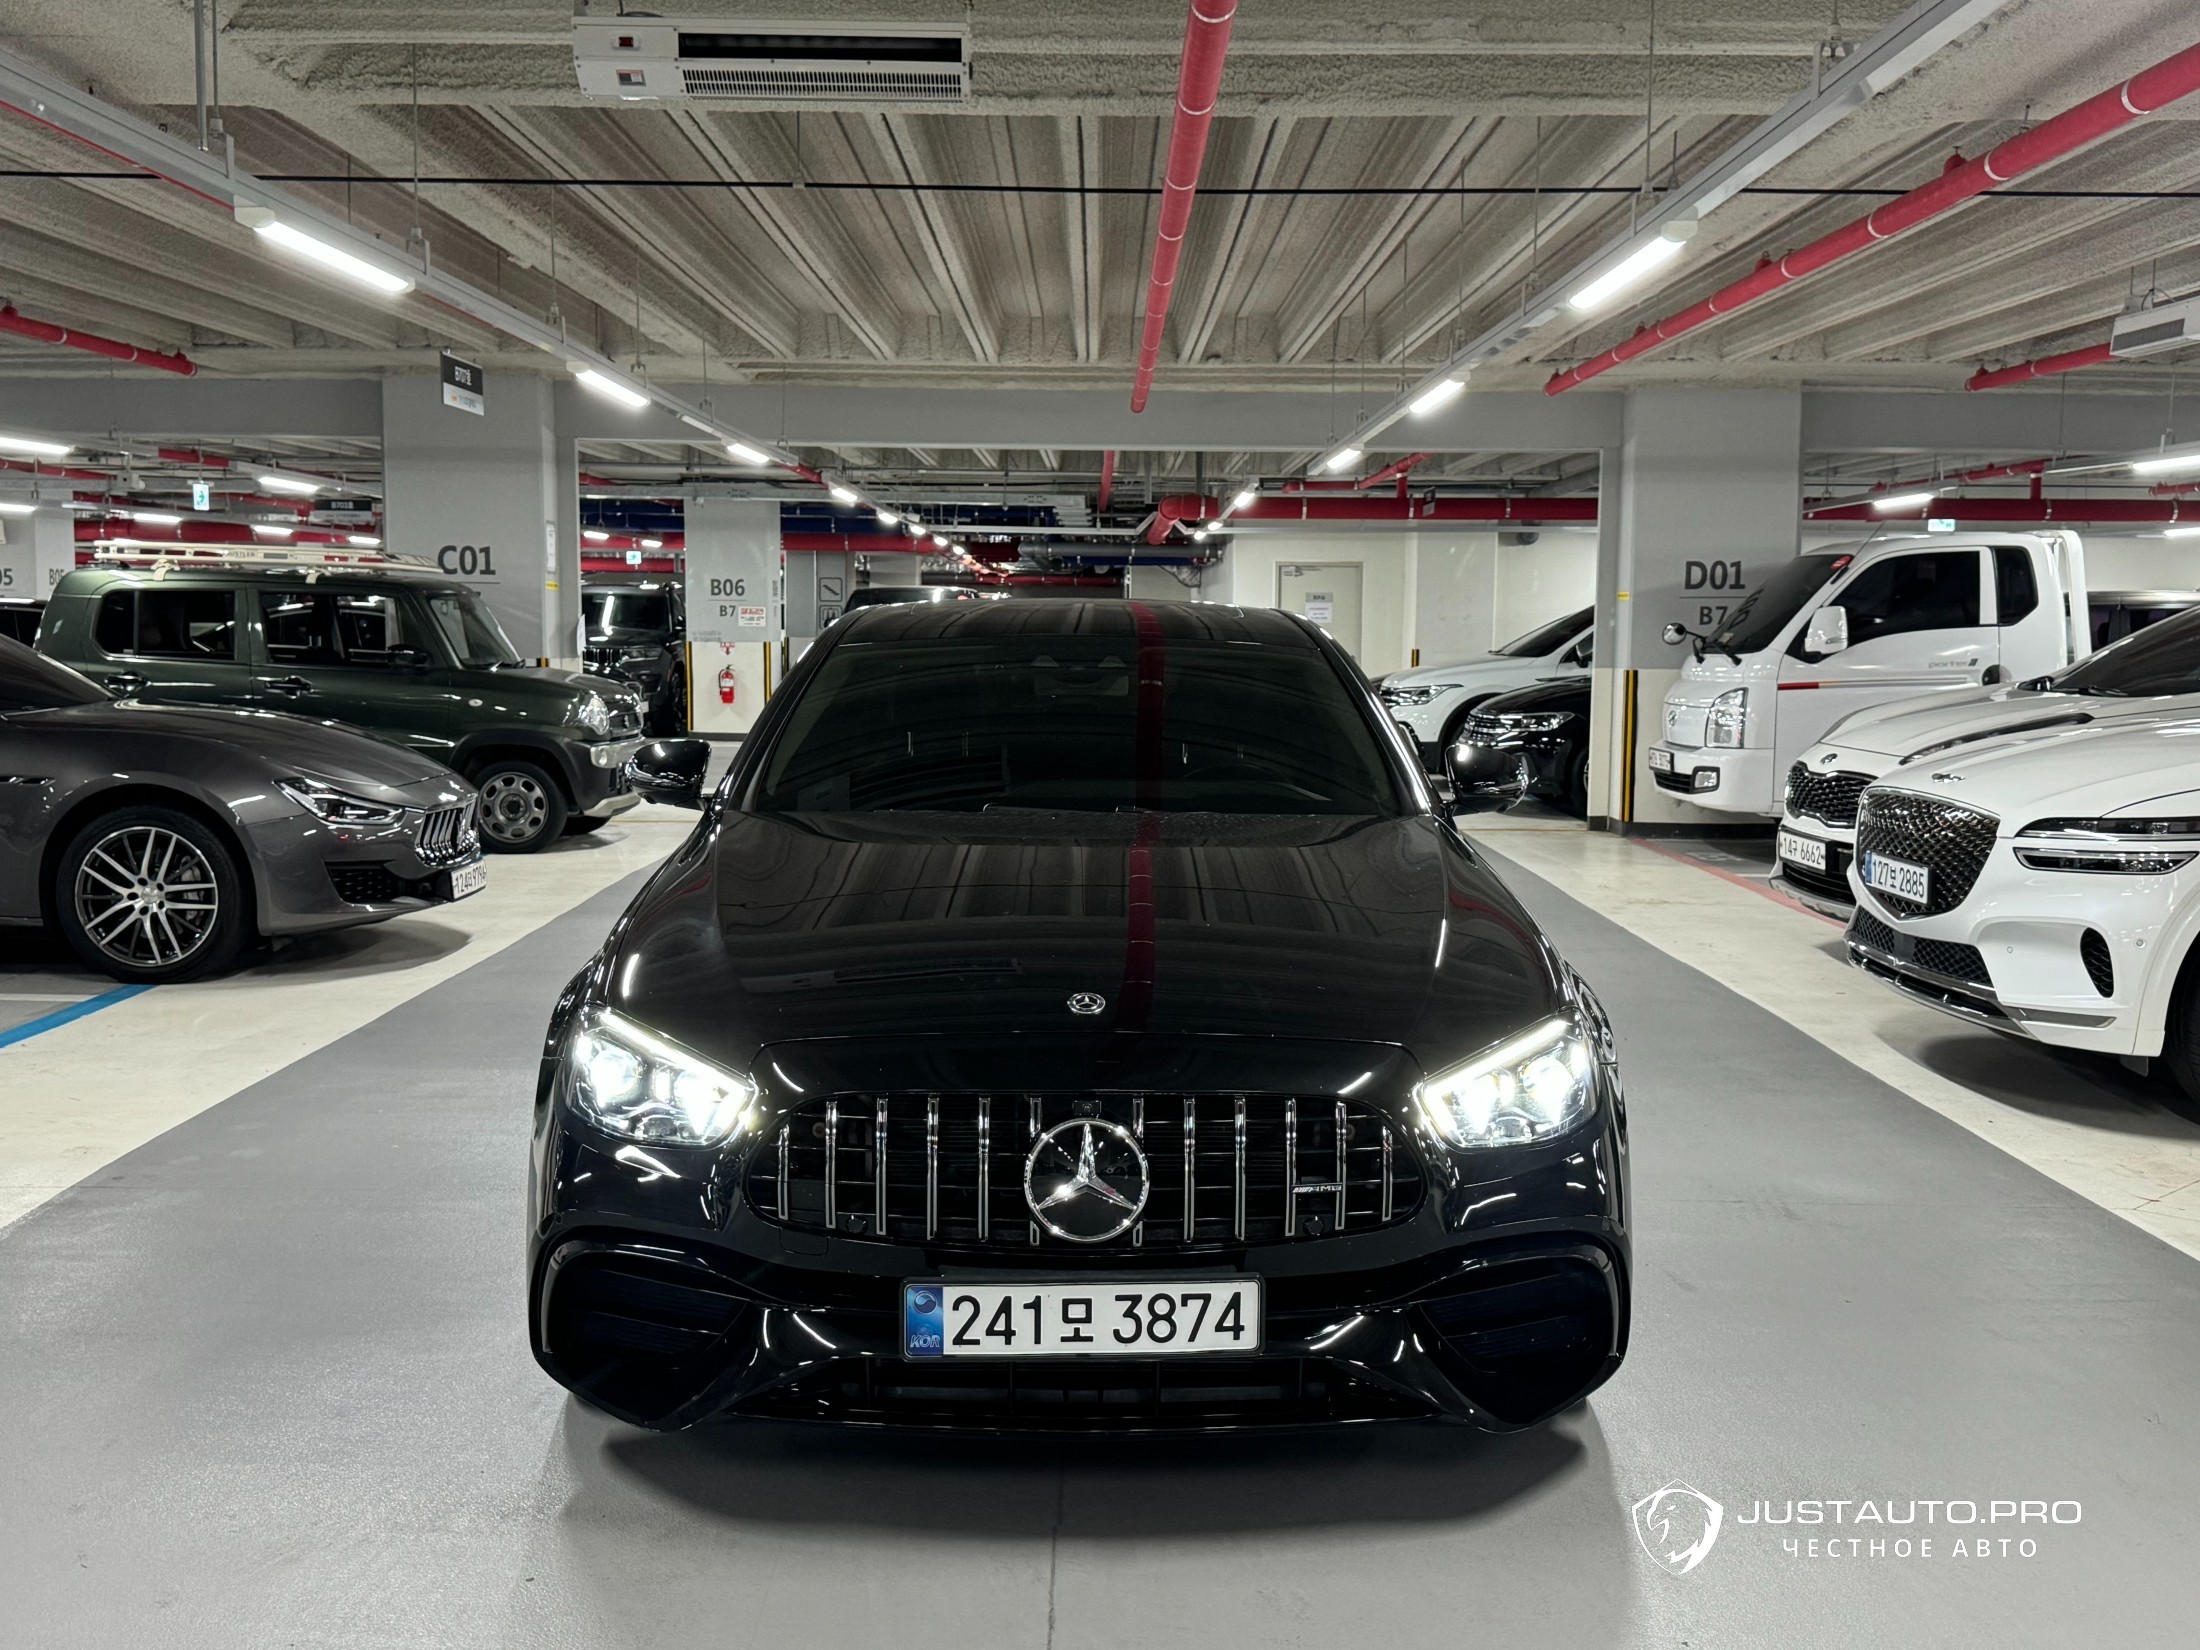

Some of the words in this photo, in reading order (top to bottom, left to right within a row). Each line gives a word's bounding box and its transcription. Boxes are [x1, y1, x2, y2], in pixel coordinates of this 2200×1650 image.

[437, 545, 496, 575] C01
[1684, 560, 1746, 590] D01
[710, 579, 745, 596] B06
[719, 605, 736, 617] B7
[1699, 606, 1728, 625] B7
[1800, 842, 1822, 865] 6662
[1899, 867, 1925, 898] 2885
[1112, 1291, 1246, 1344] 3874
[909, 1334, 941, 1348] KOR
